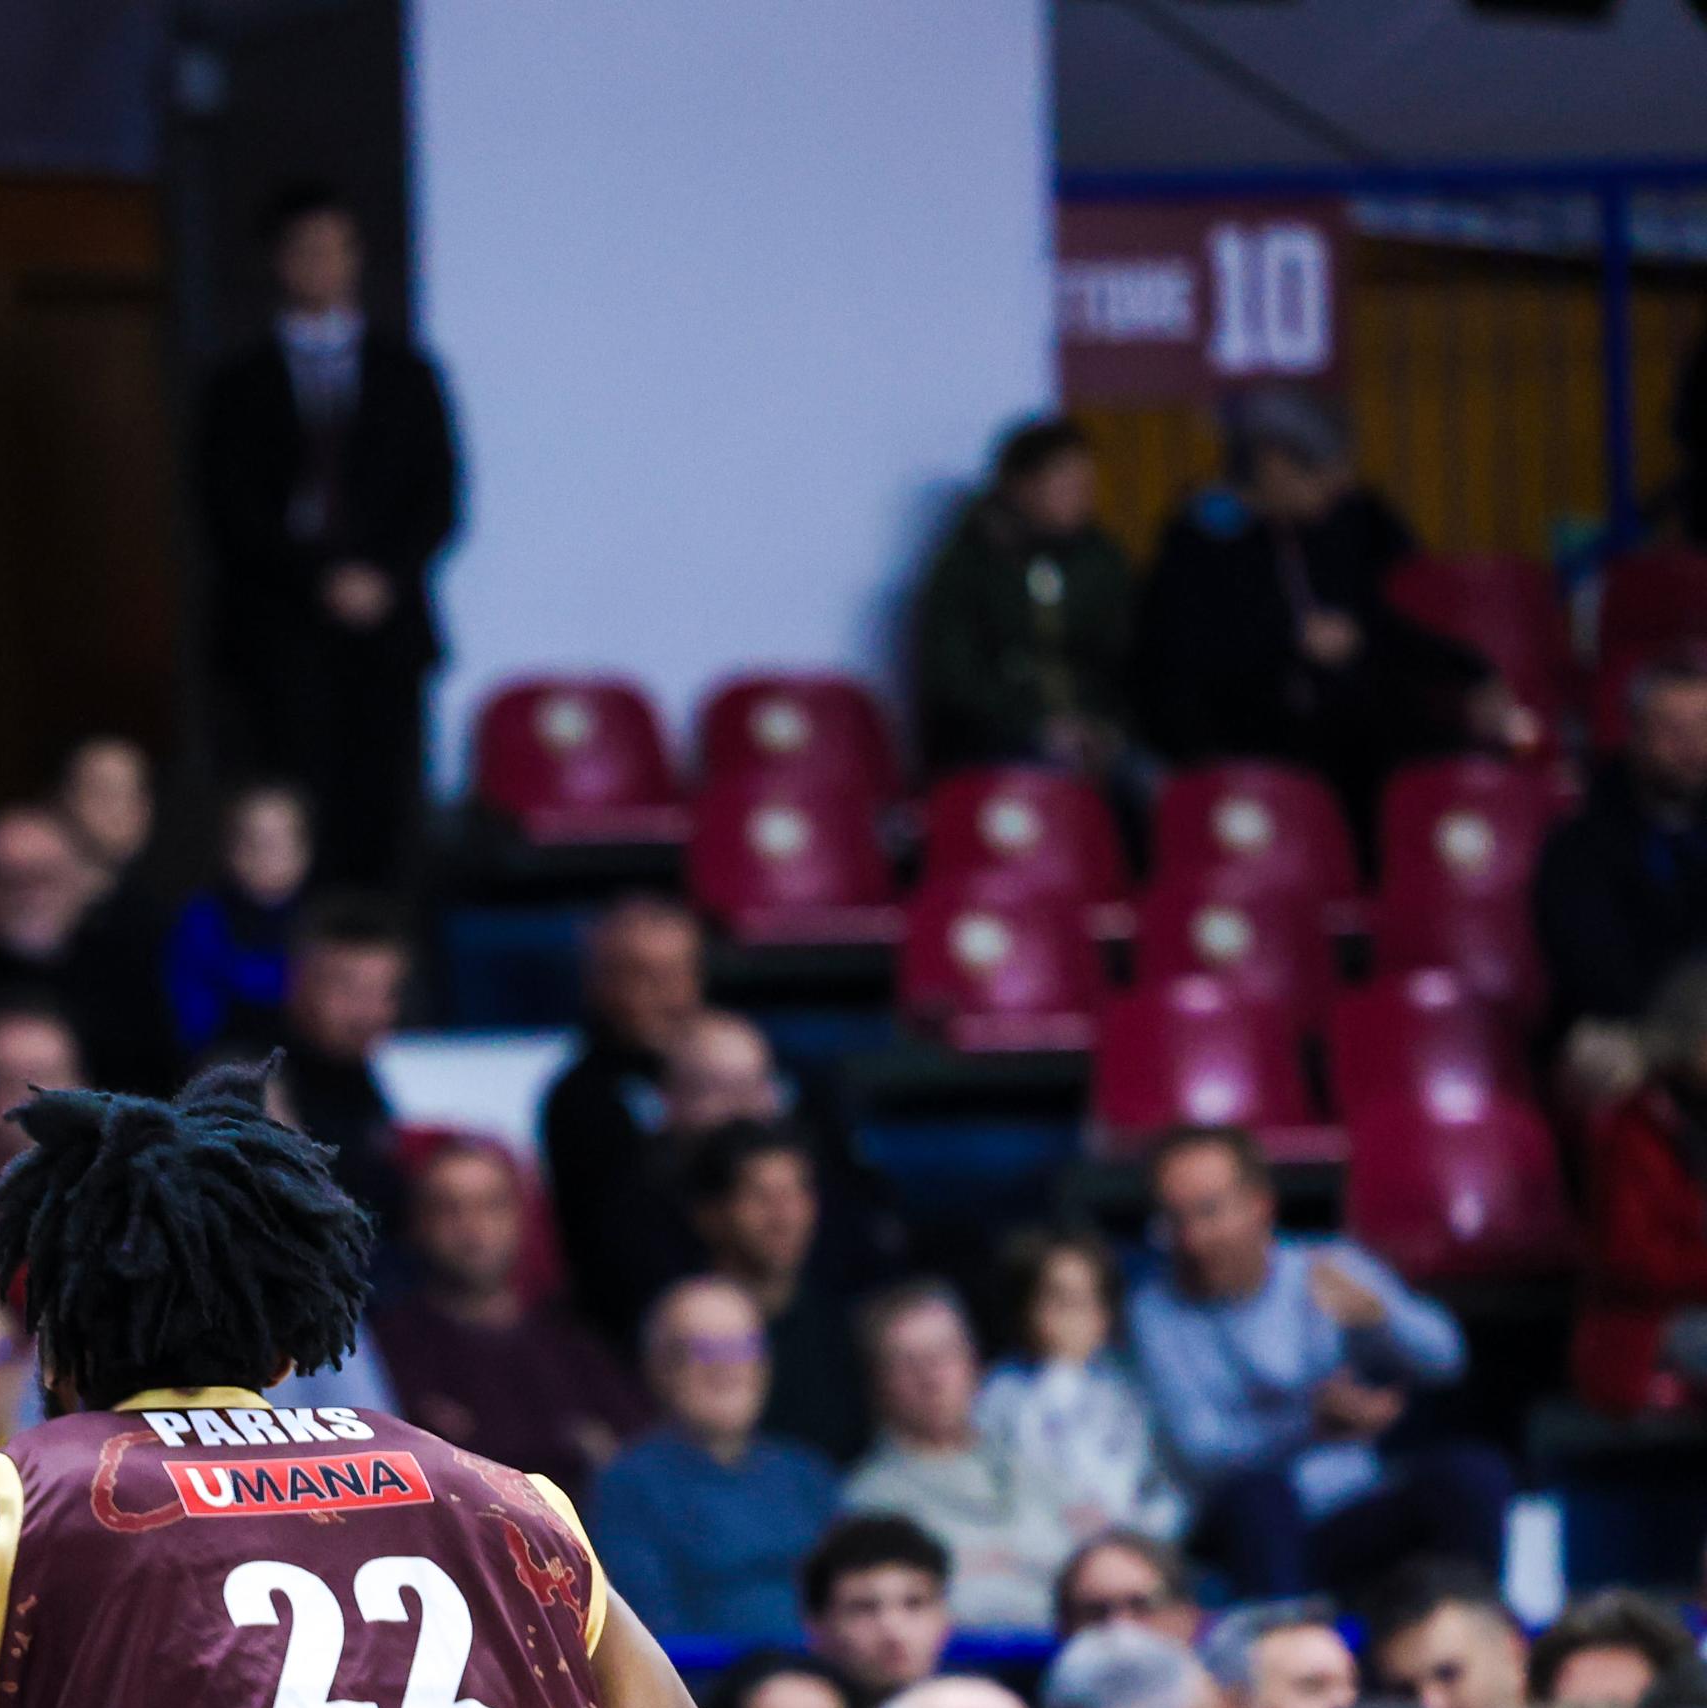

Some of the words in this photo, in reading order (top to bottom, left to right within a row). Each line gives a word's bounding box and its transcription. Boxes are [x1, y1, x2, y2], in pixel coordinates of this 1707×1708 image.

[1210, 225, 1329, 371] 10
[142, 1407, 375, 1447] PARKS
[185, 1459, 412, 1507] UMANA
